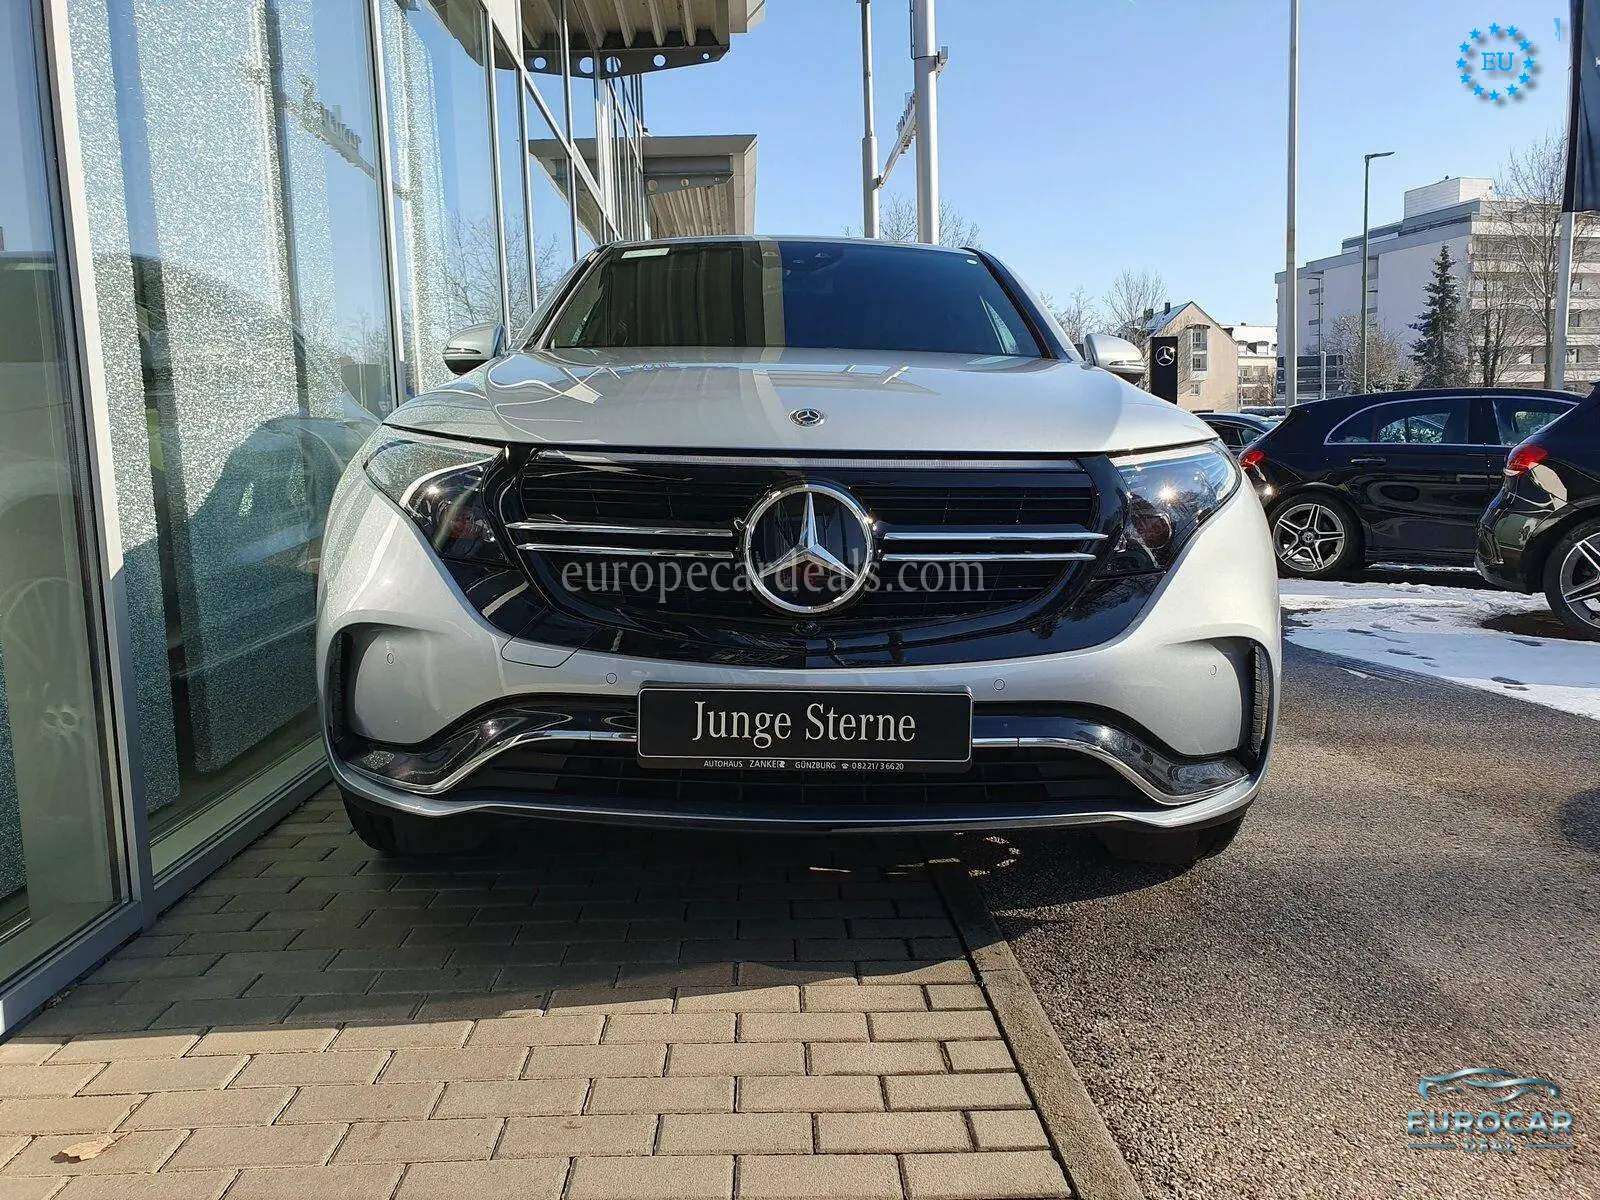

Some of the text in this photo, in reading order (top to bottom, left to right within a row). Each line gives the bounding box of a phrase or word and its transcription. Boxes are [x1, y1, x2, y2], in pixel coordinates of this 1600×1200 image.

[692, 700, 916, 749] Junge Sterne
[703, 759, 743, 769] AUTOHAUS
[795, 760, 837, 770] GÜNZBURG
